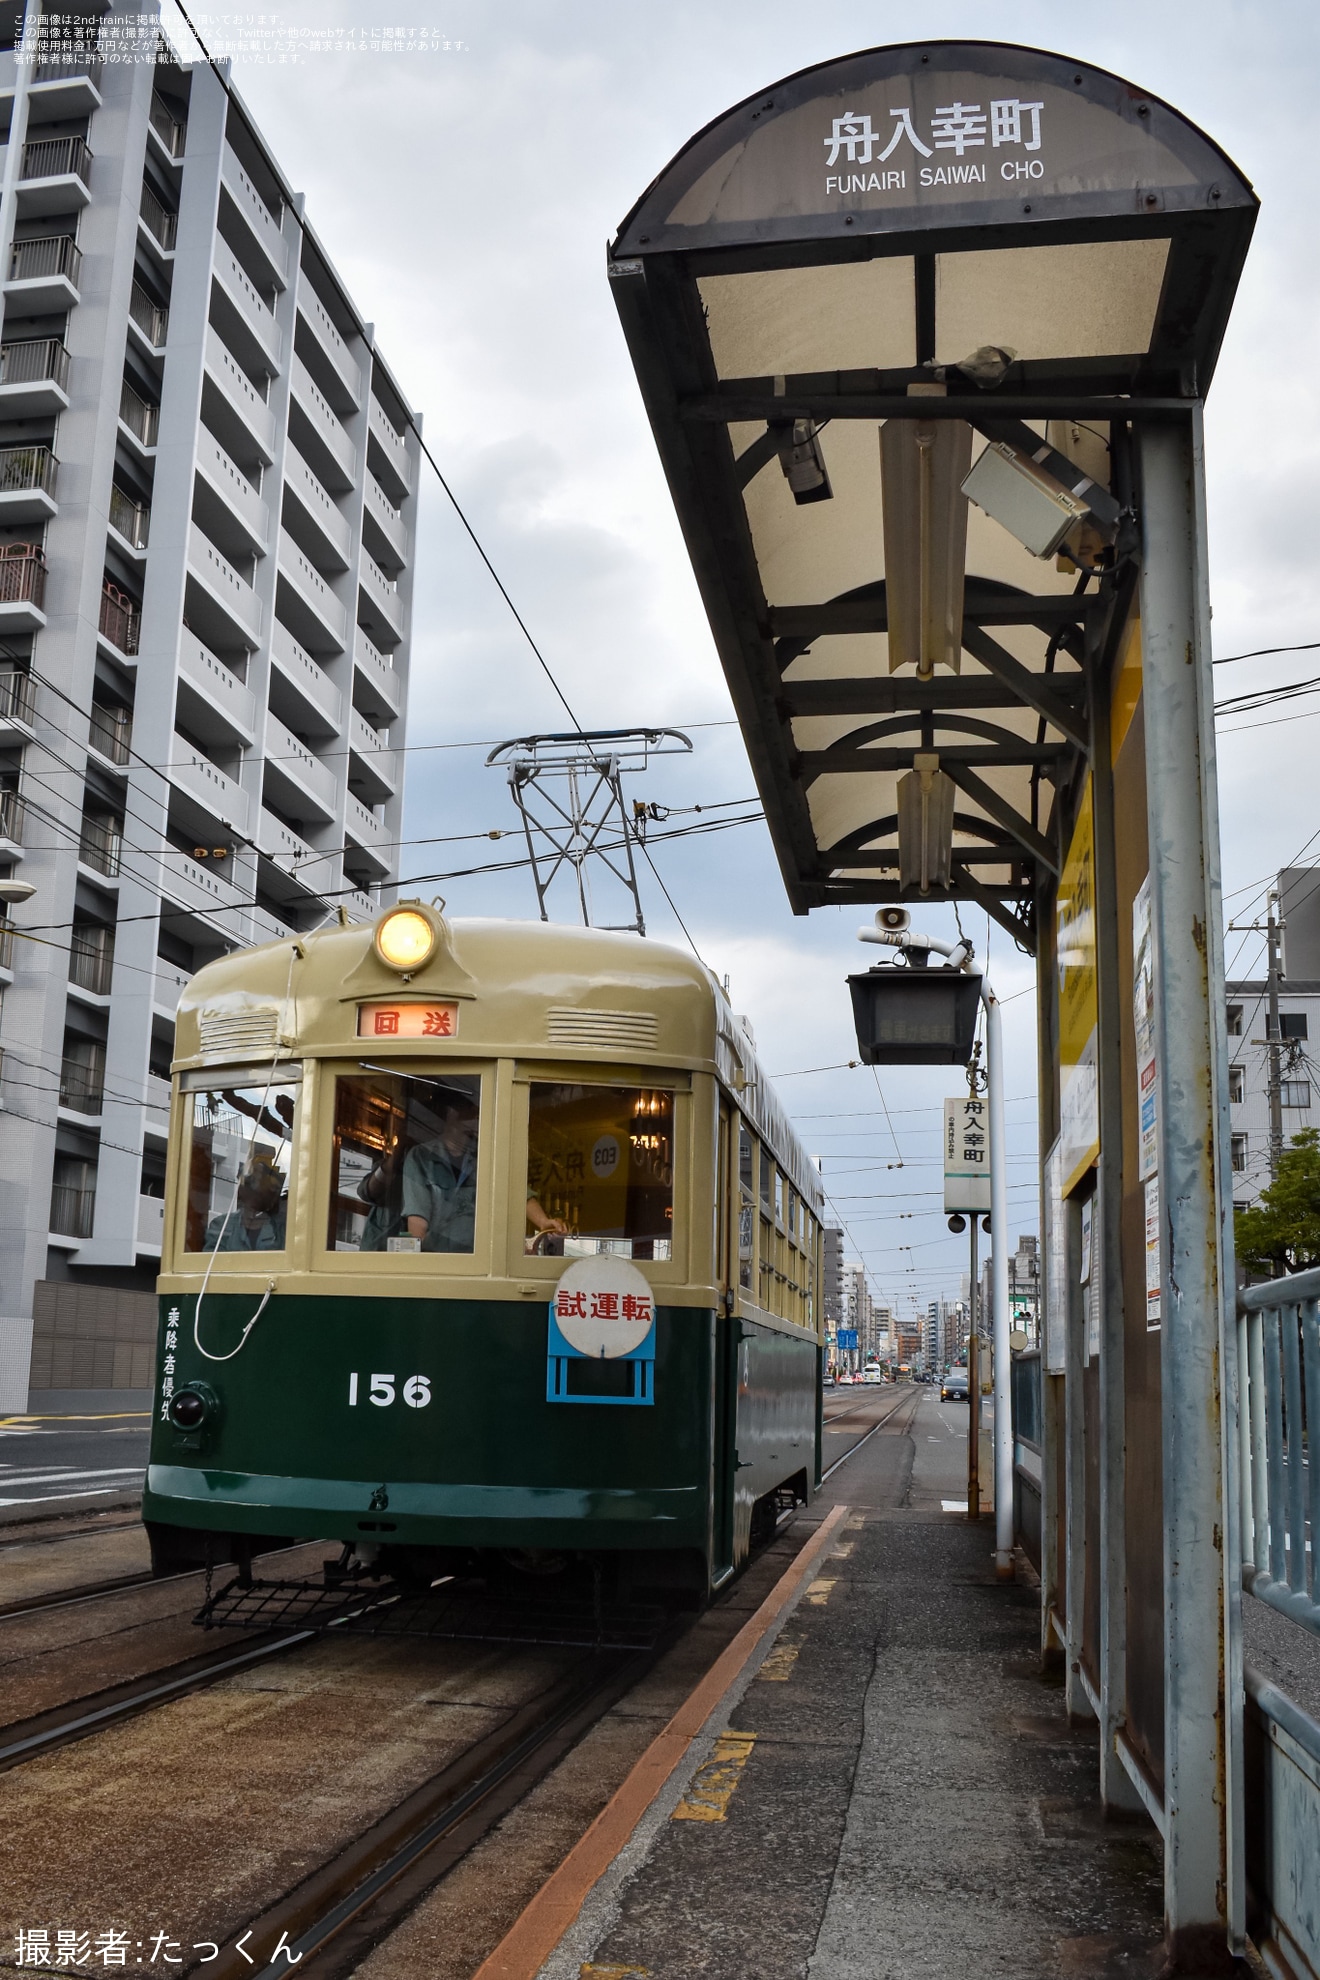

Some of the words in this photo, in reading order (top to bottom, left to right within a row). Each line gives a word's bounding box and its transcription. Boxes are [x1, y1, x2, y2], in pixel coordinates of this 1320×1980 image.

[824, 99, 1044, 167] 舟入幸町
[826, 170, 905, 194] FUNAIRI
[919, 164, 986, 187] SAIWAI
[1001, 159, 1044, 181] CHO
[374, 1011, 452, 1036] 回送
[963, 1101, 985, 1162] 舟入幸町
[557, 1290, 651, 1321] 試運転
[349, 1372, 432, 1408] 156
